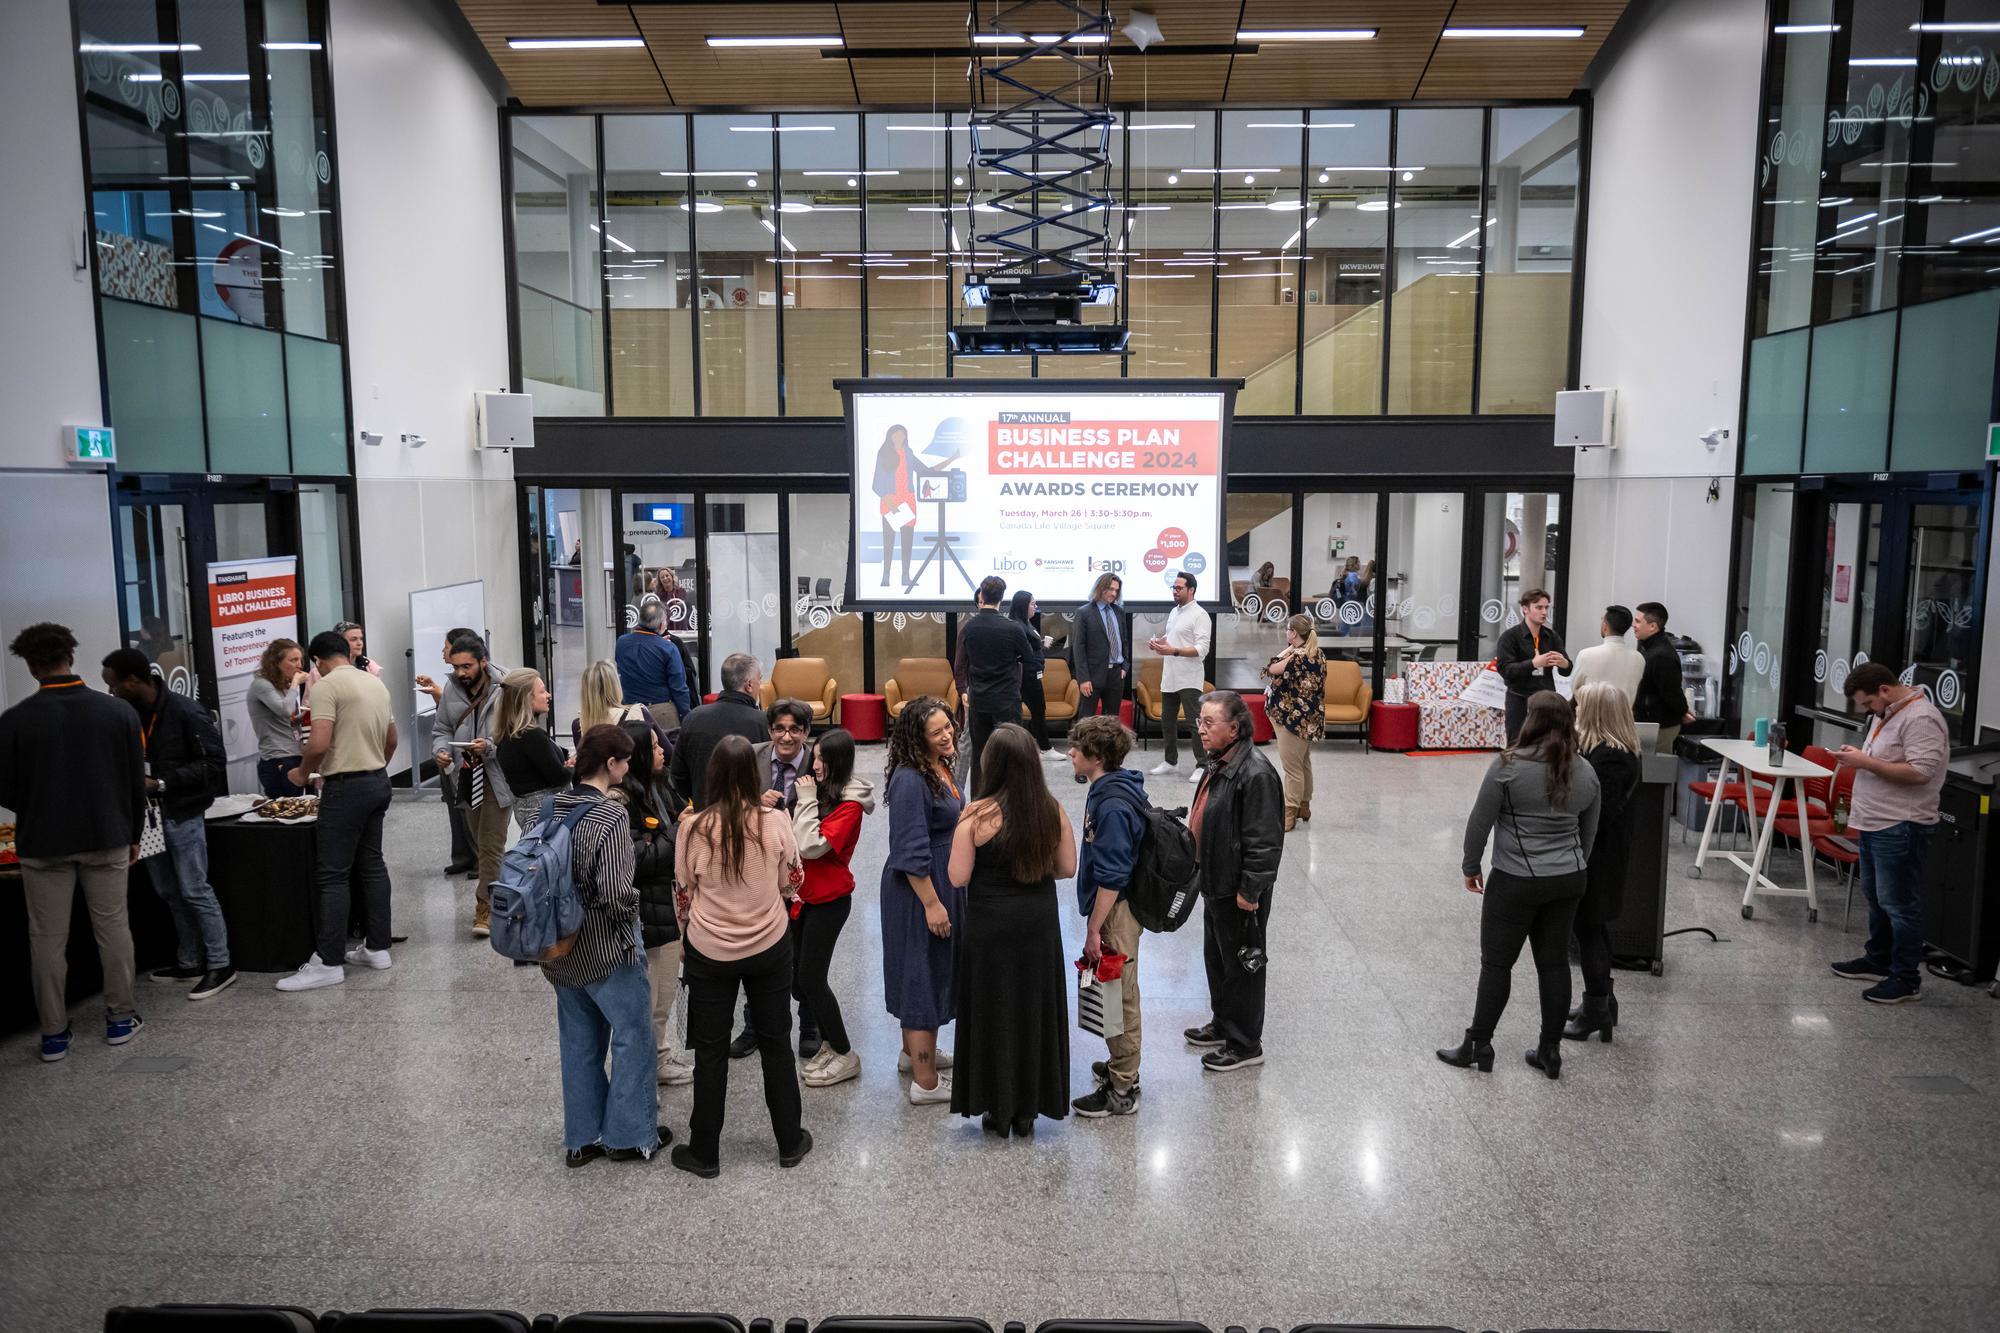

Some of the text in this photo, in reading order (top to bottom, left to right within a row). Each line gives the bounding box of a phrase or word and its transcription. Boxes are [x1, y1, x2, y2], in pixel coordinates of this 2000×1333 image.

[1002, 413, 1067, 423] 17th ANNUAL
[997, 428, 1180, 446] BUSINESS PLAN
[997, 451, 1198, 468] CHALLENGE 2024
[1000, 482, 1199, 497] AWARDS CEREMONY
[1000, 509, 1039, 519] Tuesday,
[1041, 509, 1068, 517] March
[1071, 509, 1082, 517] 26
[1090, 509, 1152, 519] 3:30-5:30p.m.
[1000, 521, 1116, 531] Canada Life Village Square
[1160, 540, 1185, 549] $1,500
[993, 556, 1028, 571] Libro
[217, 587, 285, 604] LIBRO BUSINESS
[219, 597, 292, 616] PLAN CHALLENGE
[222, 628, 266, 642] Featuring the
[223, 641, 269, 655] Entrepreneurs
[224, 655, 261, 668] of Tomorro
